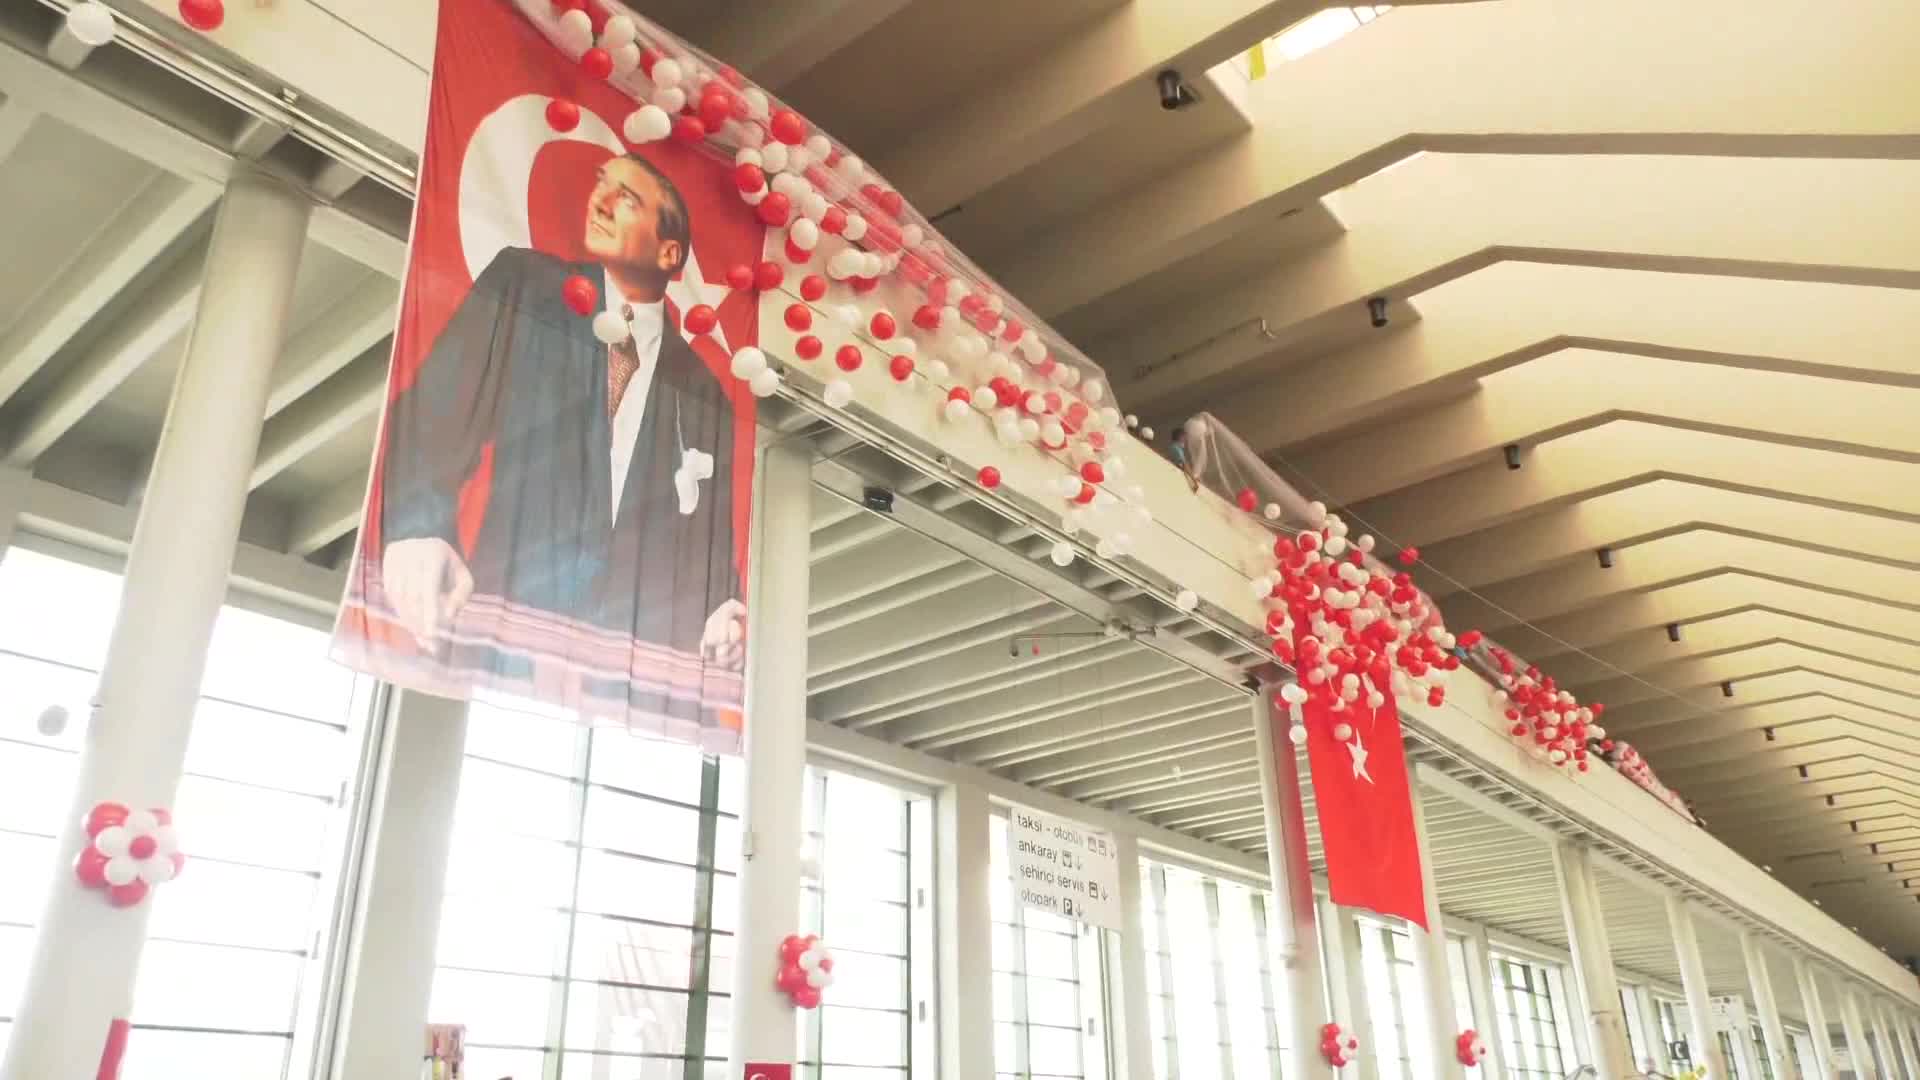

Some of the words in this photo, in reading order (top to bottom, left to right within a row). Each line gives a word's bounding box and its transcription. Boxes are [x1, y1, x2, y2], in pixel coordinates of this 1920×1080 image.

[1017, 815, 1042, 832] taksi
[1018, 840, 1058, 862] ankaray
[1057, 875, 1085, 892] servis
[1021, 888, 1058, 909] otopark
